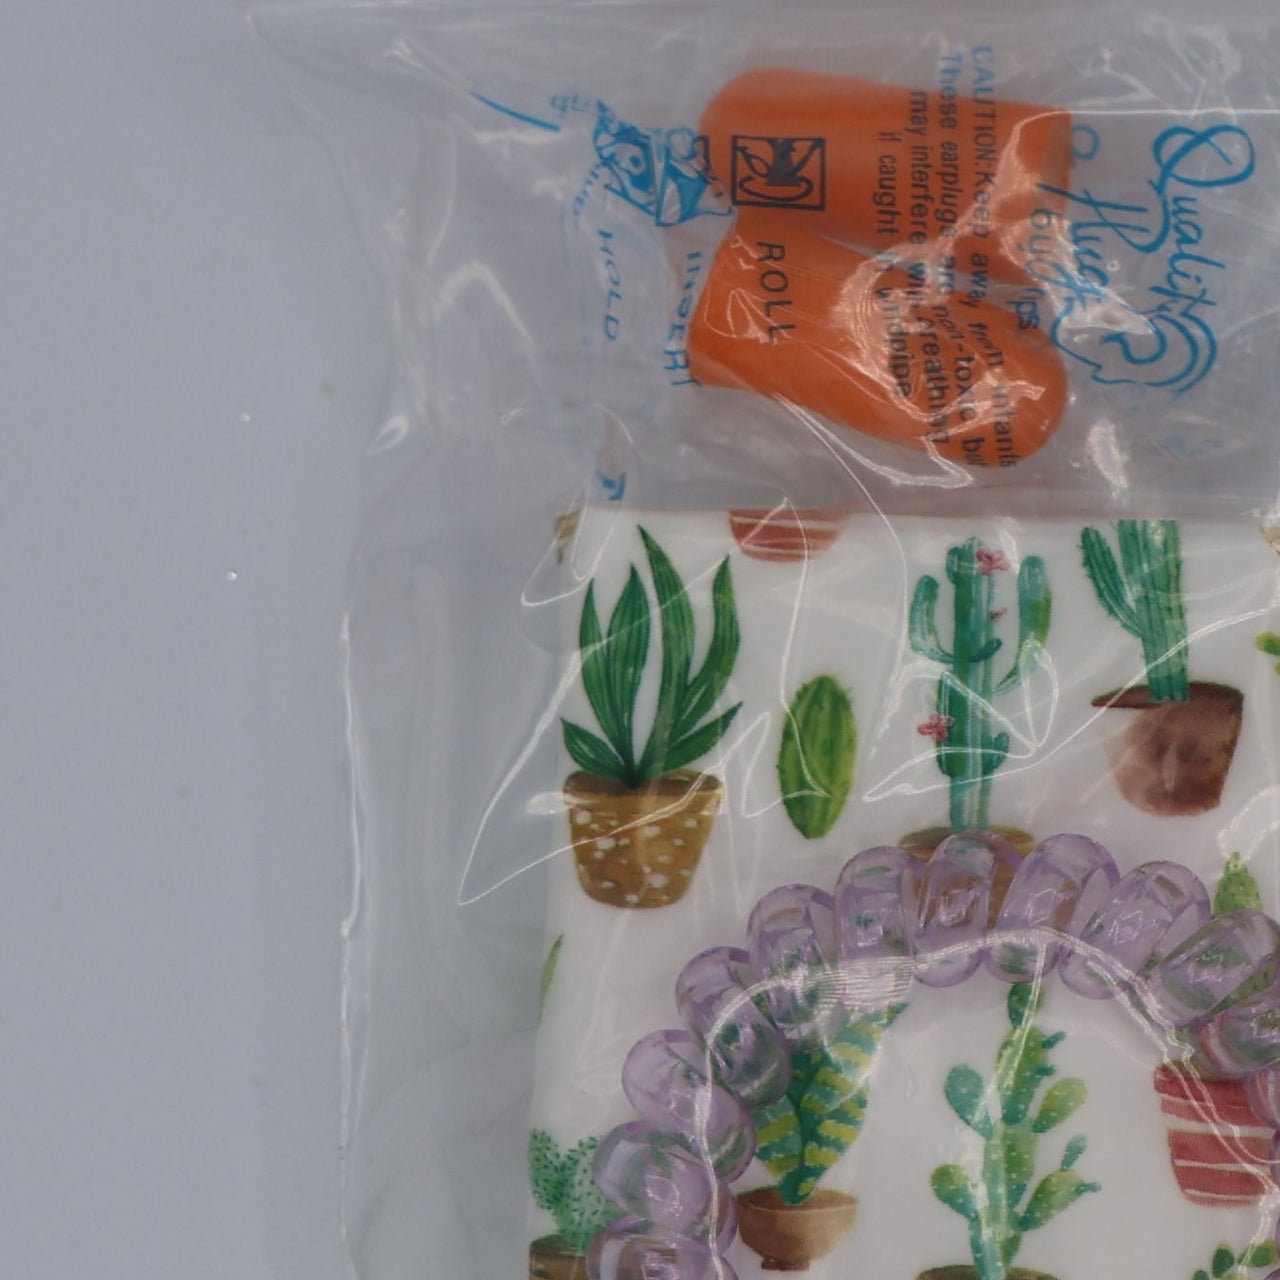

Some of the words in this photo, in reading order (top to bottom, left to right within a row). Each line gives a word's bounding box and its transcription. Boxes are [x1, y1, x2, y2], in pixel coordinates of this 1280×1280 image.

[905, 91, 928, 136] may
[939, 51, 964, 130] These
[877, 132, 903, 144] if
[872, 154, 901, 235] caught
[909, 145, 935, 245] interfere
[598, 229, 622, 342] HOLD
[756, 241, 797, 345] ROLL
[959, 252, 989, 308] away
